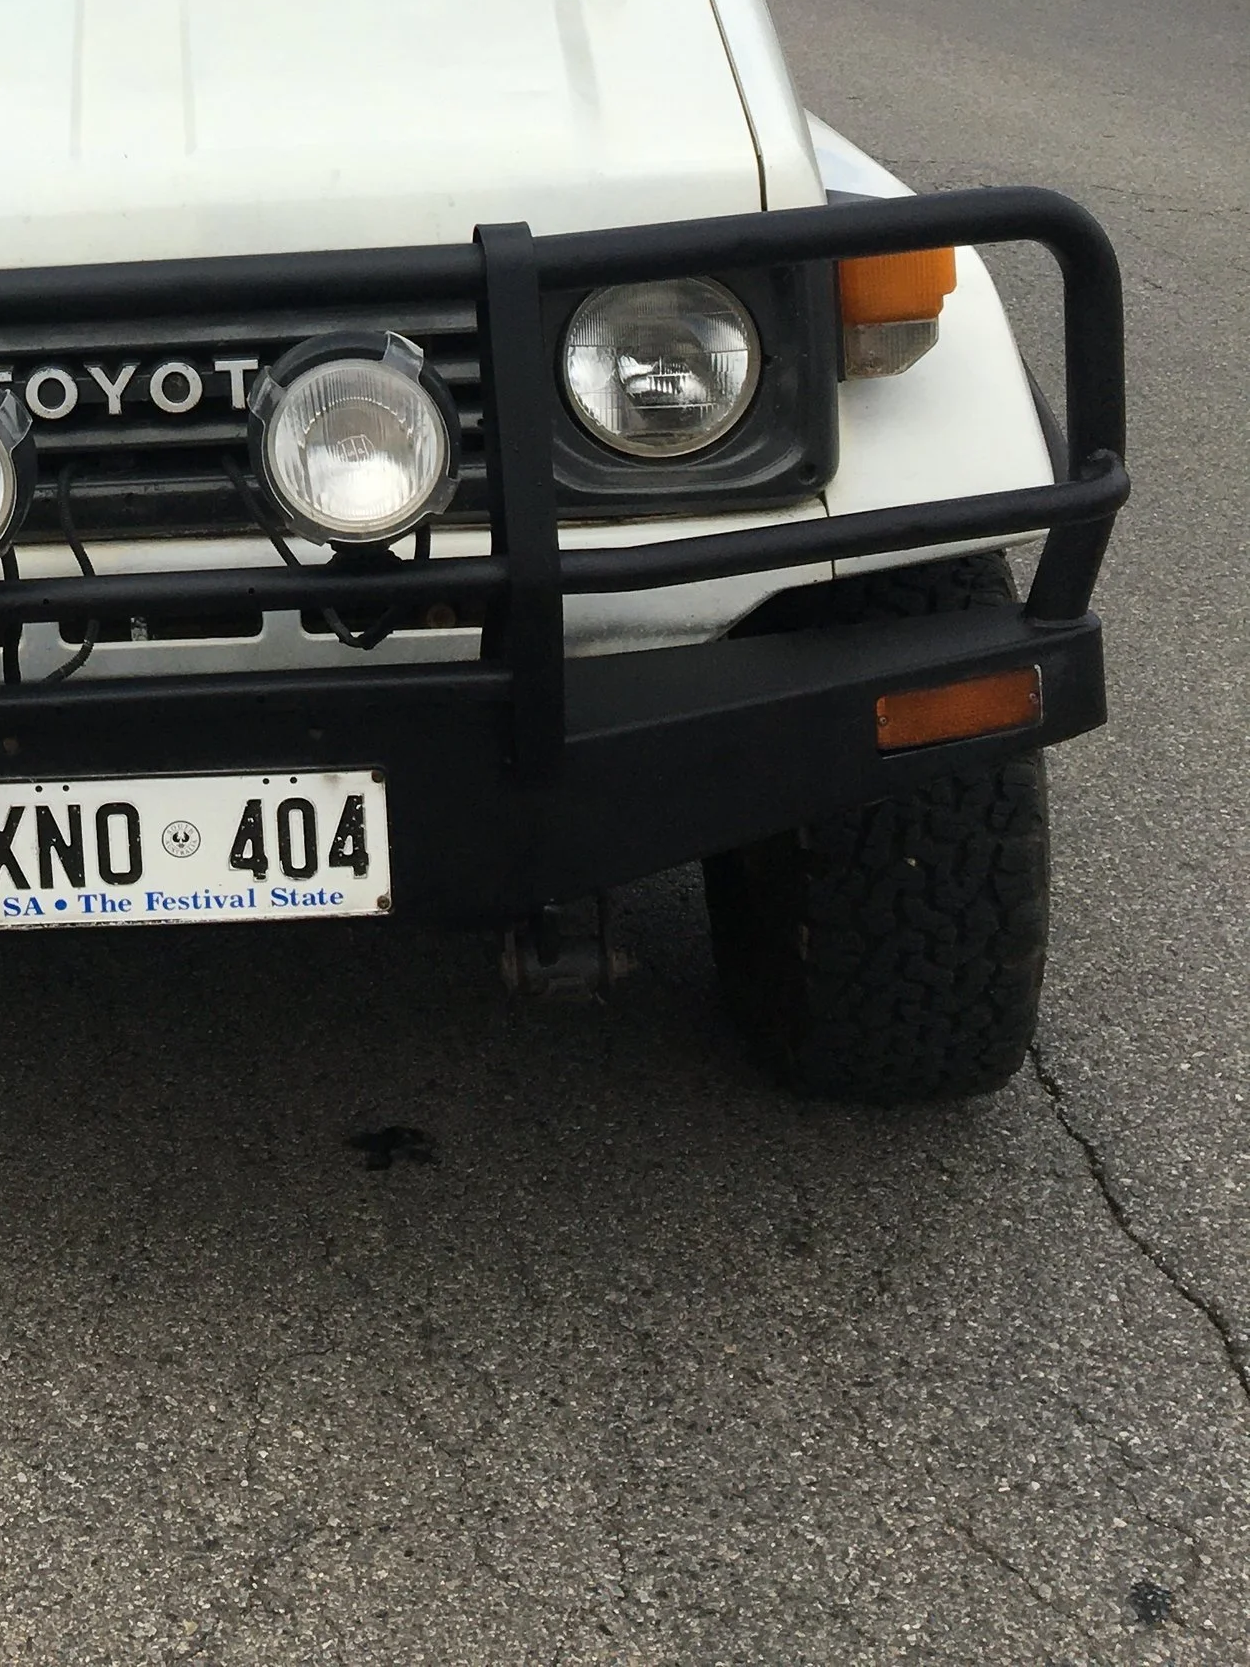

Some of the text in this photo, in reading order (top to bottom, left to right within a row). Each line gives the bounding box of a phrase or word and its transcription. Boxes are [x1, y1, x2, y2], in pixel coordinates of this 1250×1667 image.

[228, 794, 370, 883] 404
[2, 886, 345, 917] SA The Festival State
